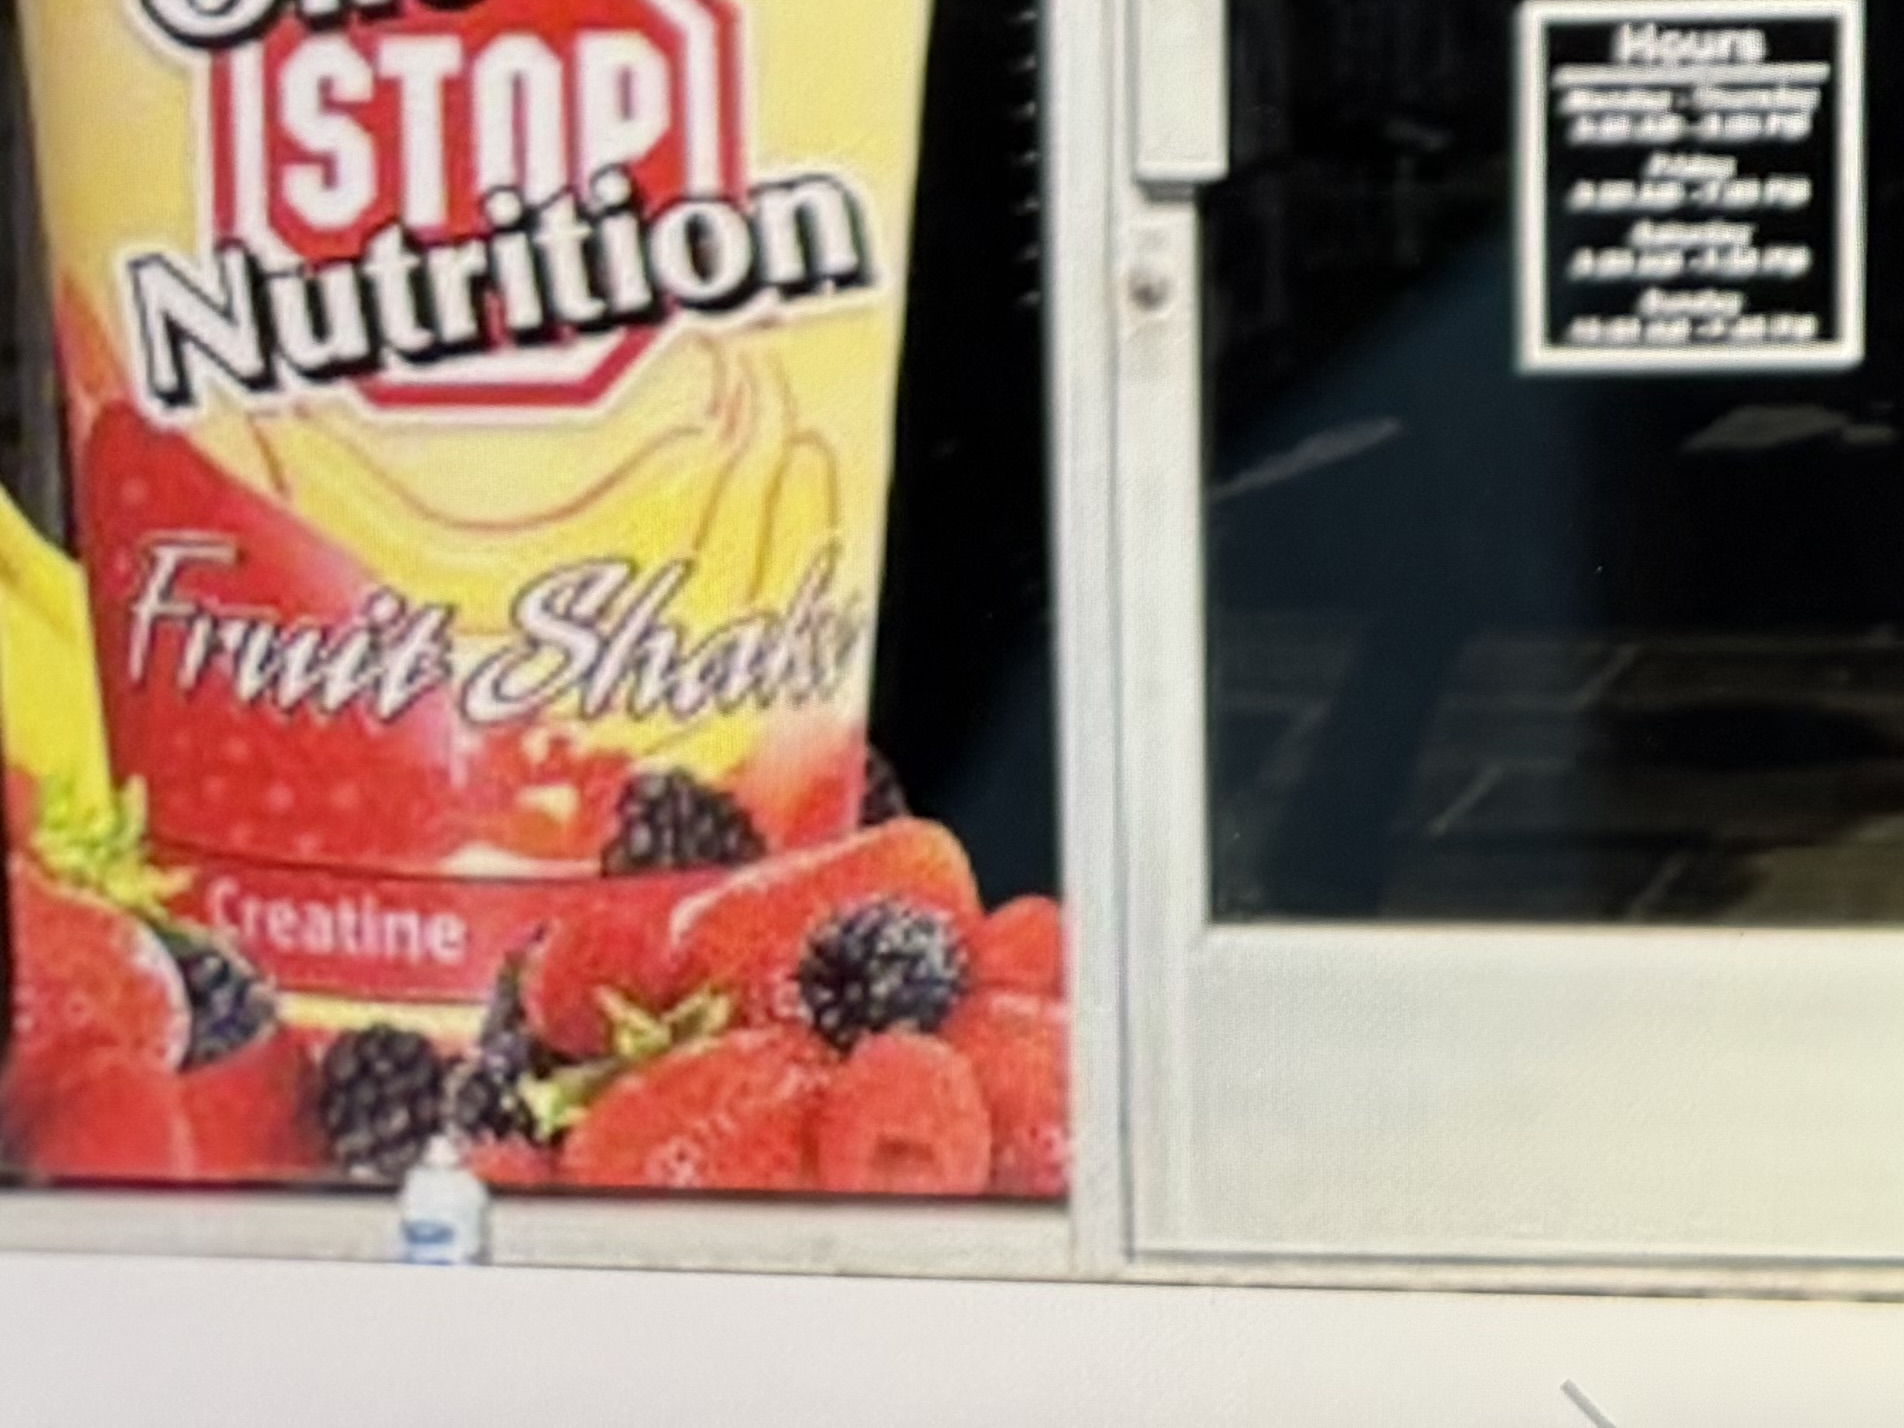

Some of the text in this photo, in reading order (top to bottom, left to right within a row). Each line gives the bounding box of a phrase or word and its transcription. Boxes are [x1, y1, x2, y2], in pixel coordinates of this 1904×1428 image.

[277, 28, 673, 230] STOP
[127, 168, 876, 408] Nutrition
[125, 530, 455, 722] Fruit
[206, 877, 466, 966] Creatine
